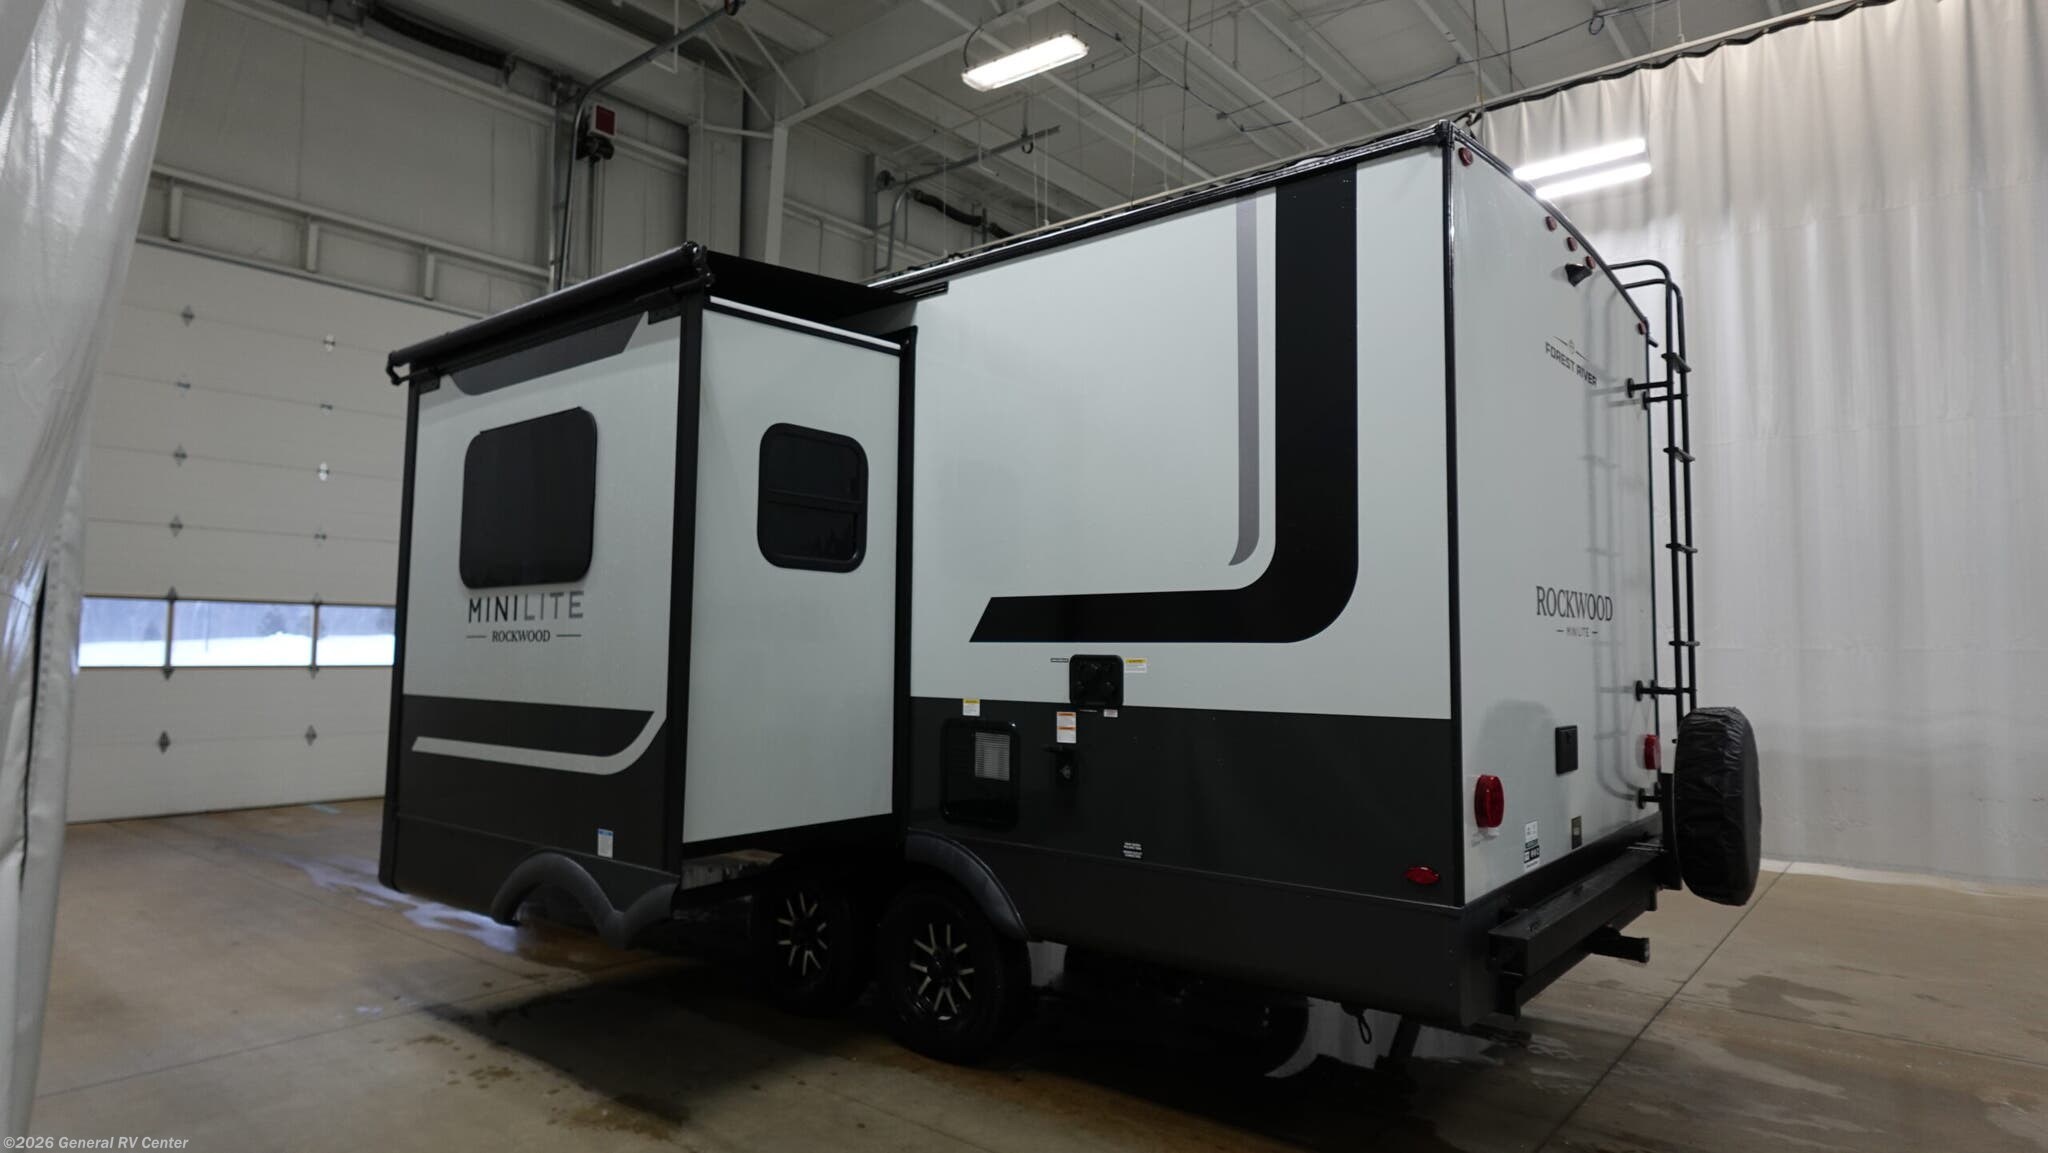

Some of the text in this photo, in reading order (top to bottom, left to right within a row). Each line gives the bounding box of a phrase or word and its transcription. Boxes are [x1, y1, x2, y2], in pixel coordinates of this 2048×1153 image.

[1545, 342, 1597, 388] FOREST RIVER
[468, 590, 584, 623] MINILITE
[1536, 585, 1613, 621] ROCKWOOD
[491, 629, 550, 642] ROCKWOOD
